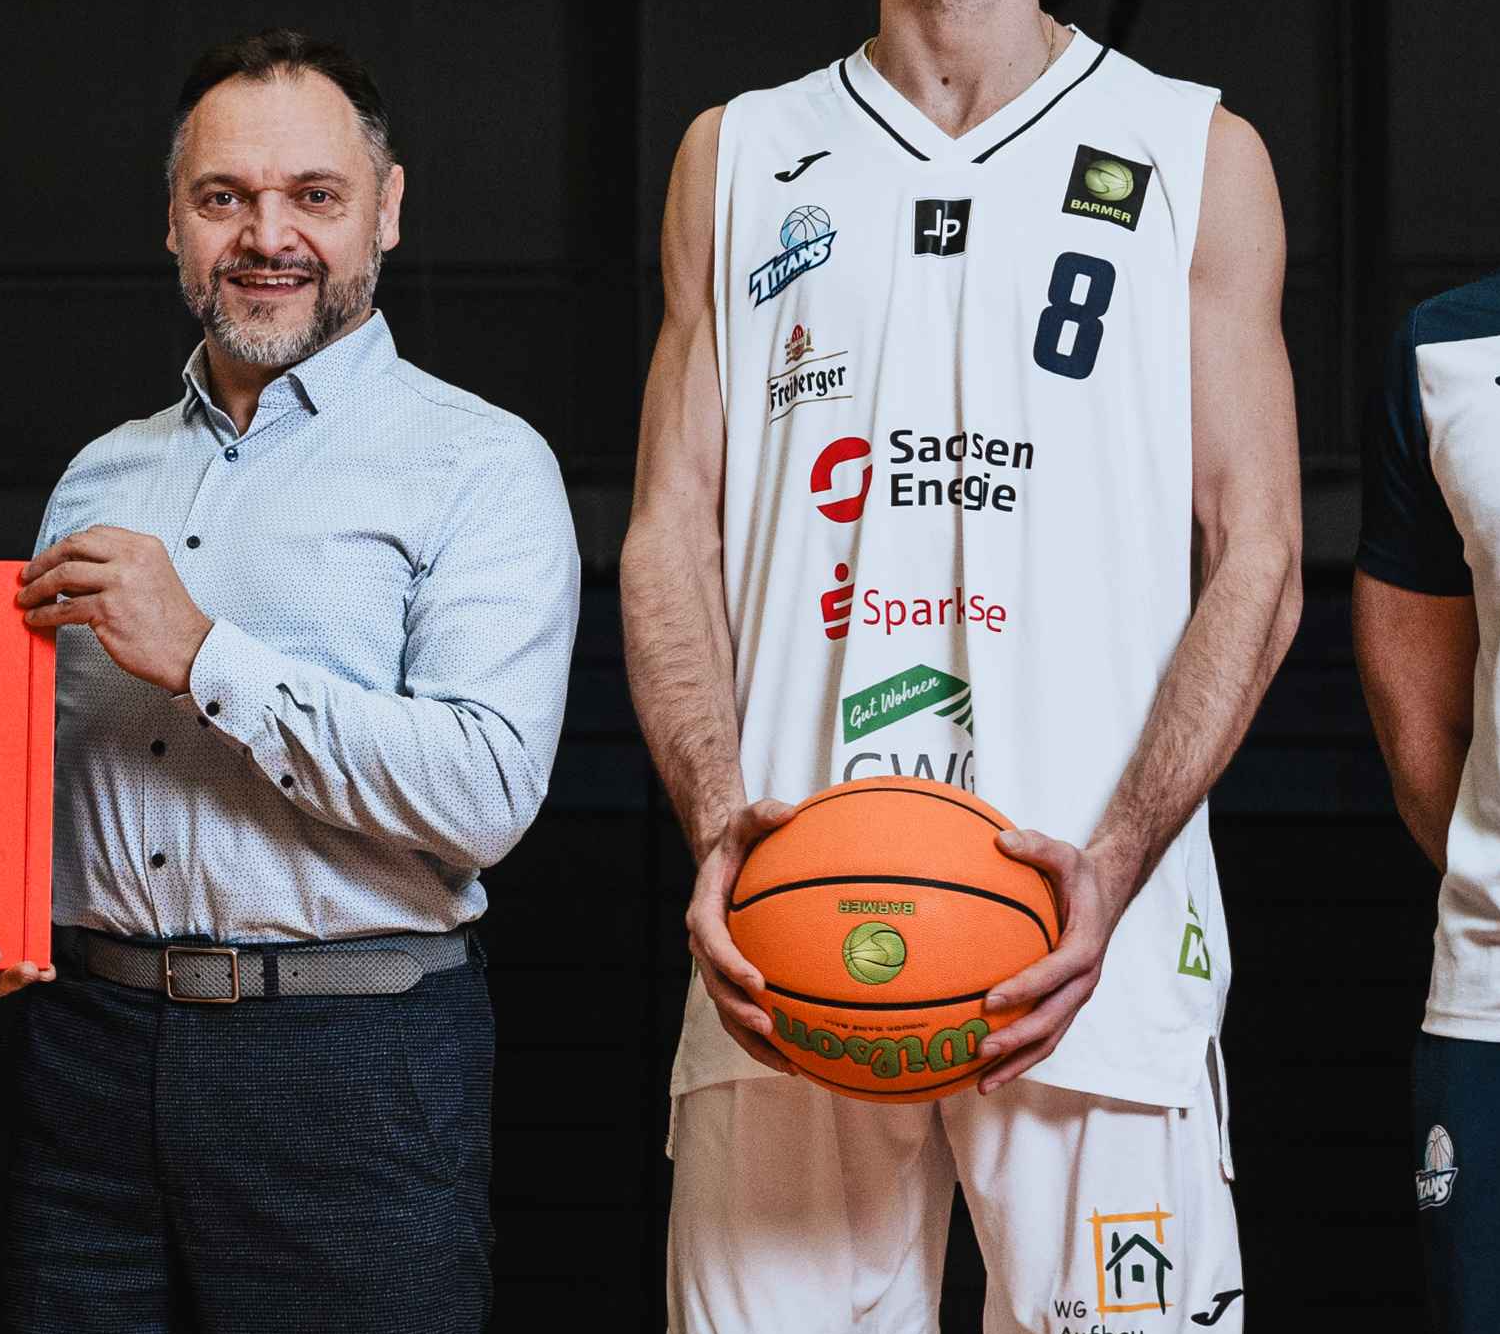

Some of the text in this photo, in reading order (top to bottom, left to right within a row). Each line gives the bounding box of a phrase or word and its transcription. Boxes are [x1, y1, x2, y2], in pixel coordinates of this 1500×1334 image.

[1070, 199, 1132, 223] BARMER
[1033, 251, 1117, 380] 8
[890, 472, 1016, 513] Enegie
[850, 677, 940, 729] Gut Wohnen
[838, 900, 915, 914] BARMER
[772, 1007, 990, 1078] Wilson
[1054, 1301, 1087, 1318] WG
